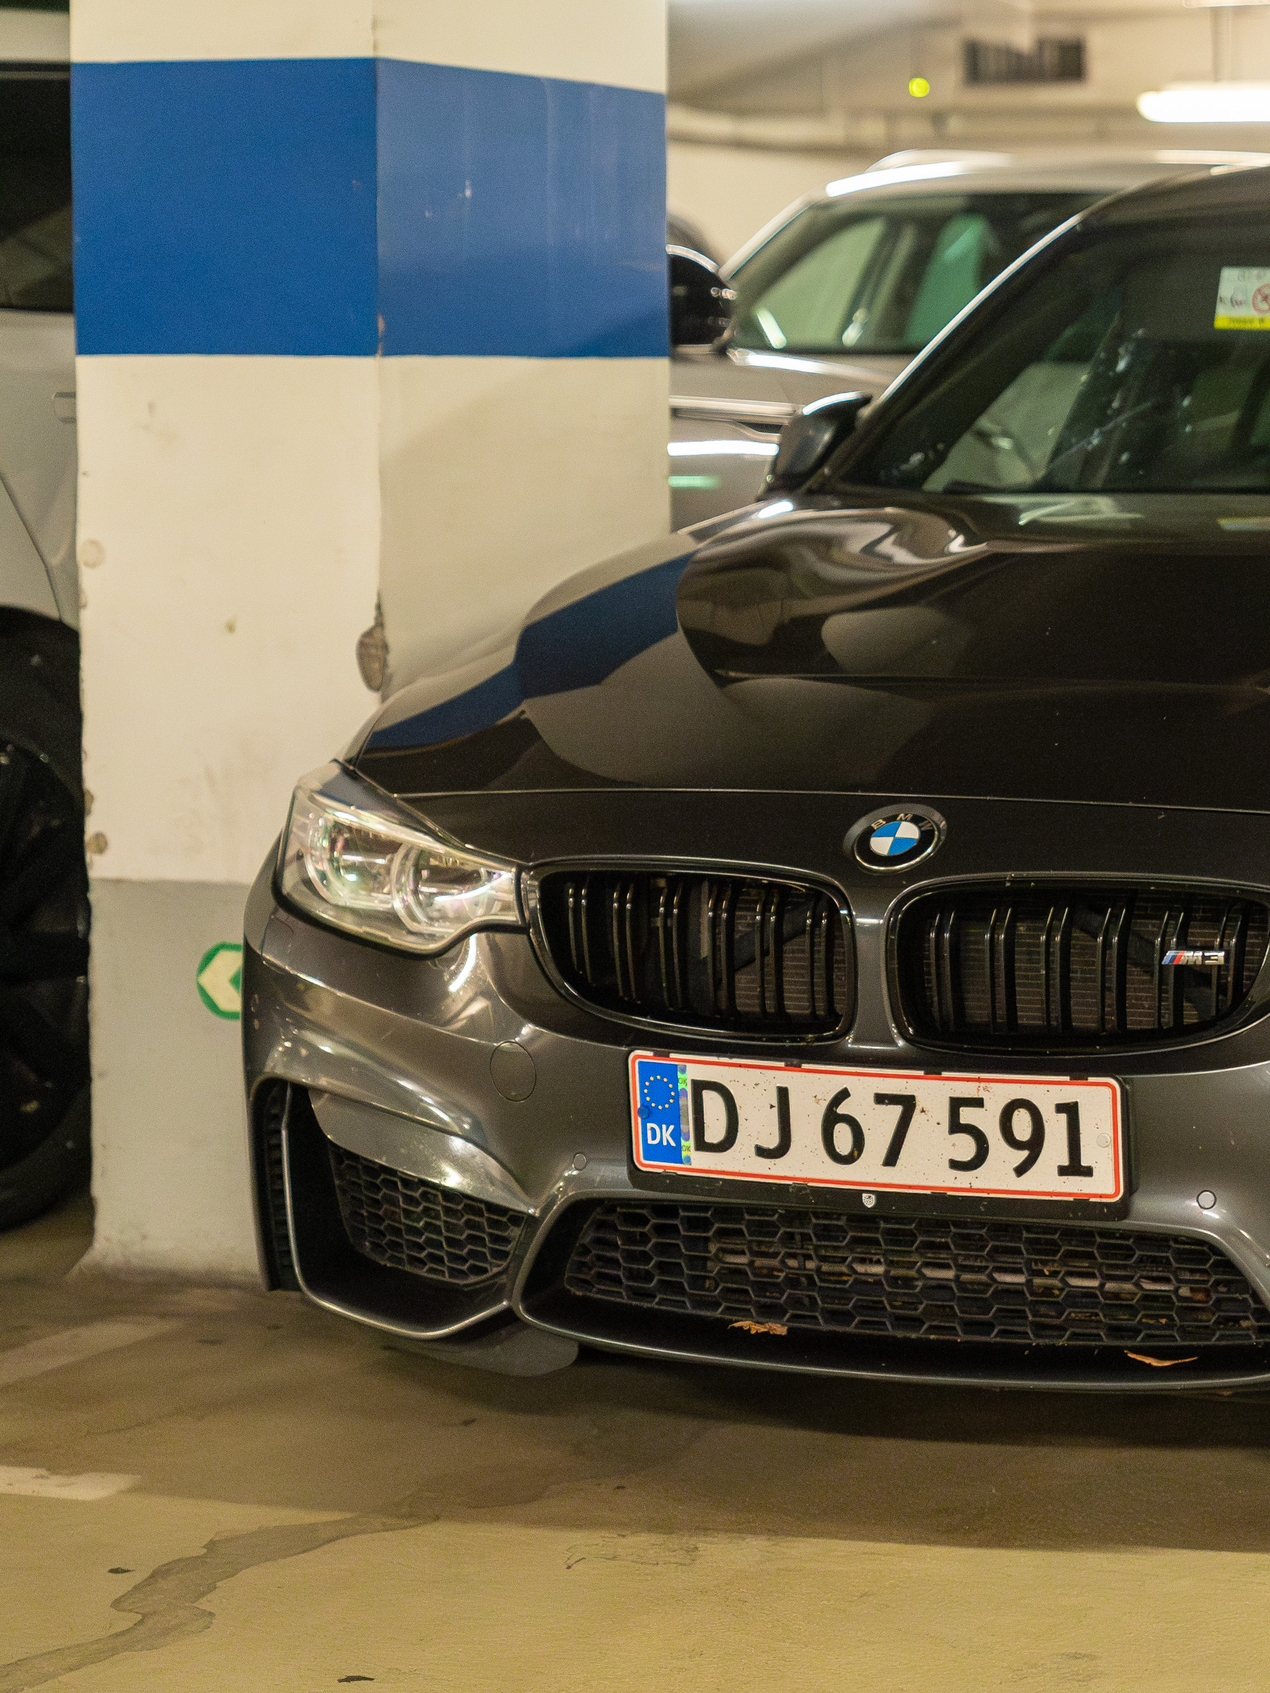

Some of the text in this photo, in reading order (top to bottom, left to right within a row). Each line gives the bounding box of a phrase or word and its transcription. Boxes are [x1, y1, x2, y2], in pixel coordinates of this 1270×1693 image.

[871, 813, 933, 831] BMW
[1178, 950, 1225, 965] M3
[646, 1123, 676, 1147] DK
[691, 1078, 1094, 1178] DJ 67 591
